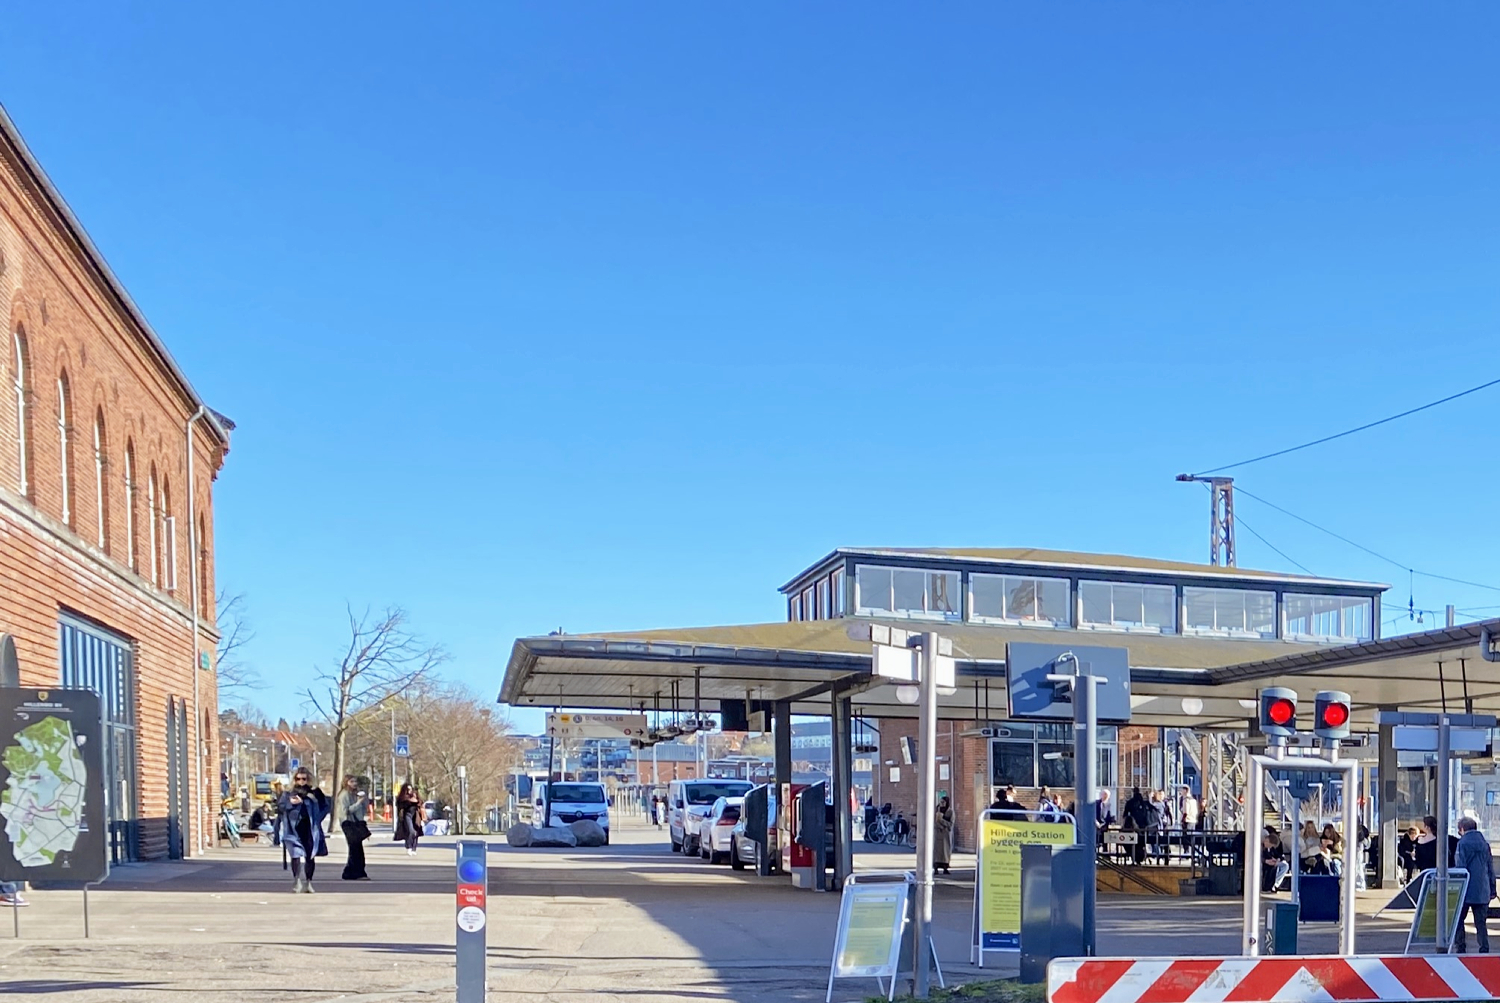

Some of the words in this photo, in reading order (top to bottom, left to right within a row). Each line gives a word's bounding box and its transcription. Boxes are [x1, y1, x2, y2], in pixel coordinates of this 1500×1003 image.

[990, 829, 1028, 838] Hillerød
[1031, 830, 1065, 839] Station
[459, 888, 484, 896] Check
